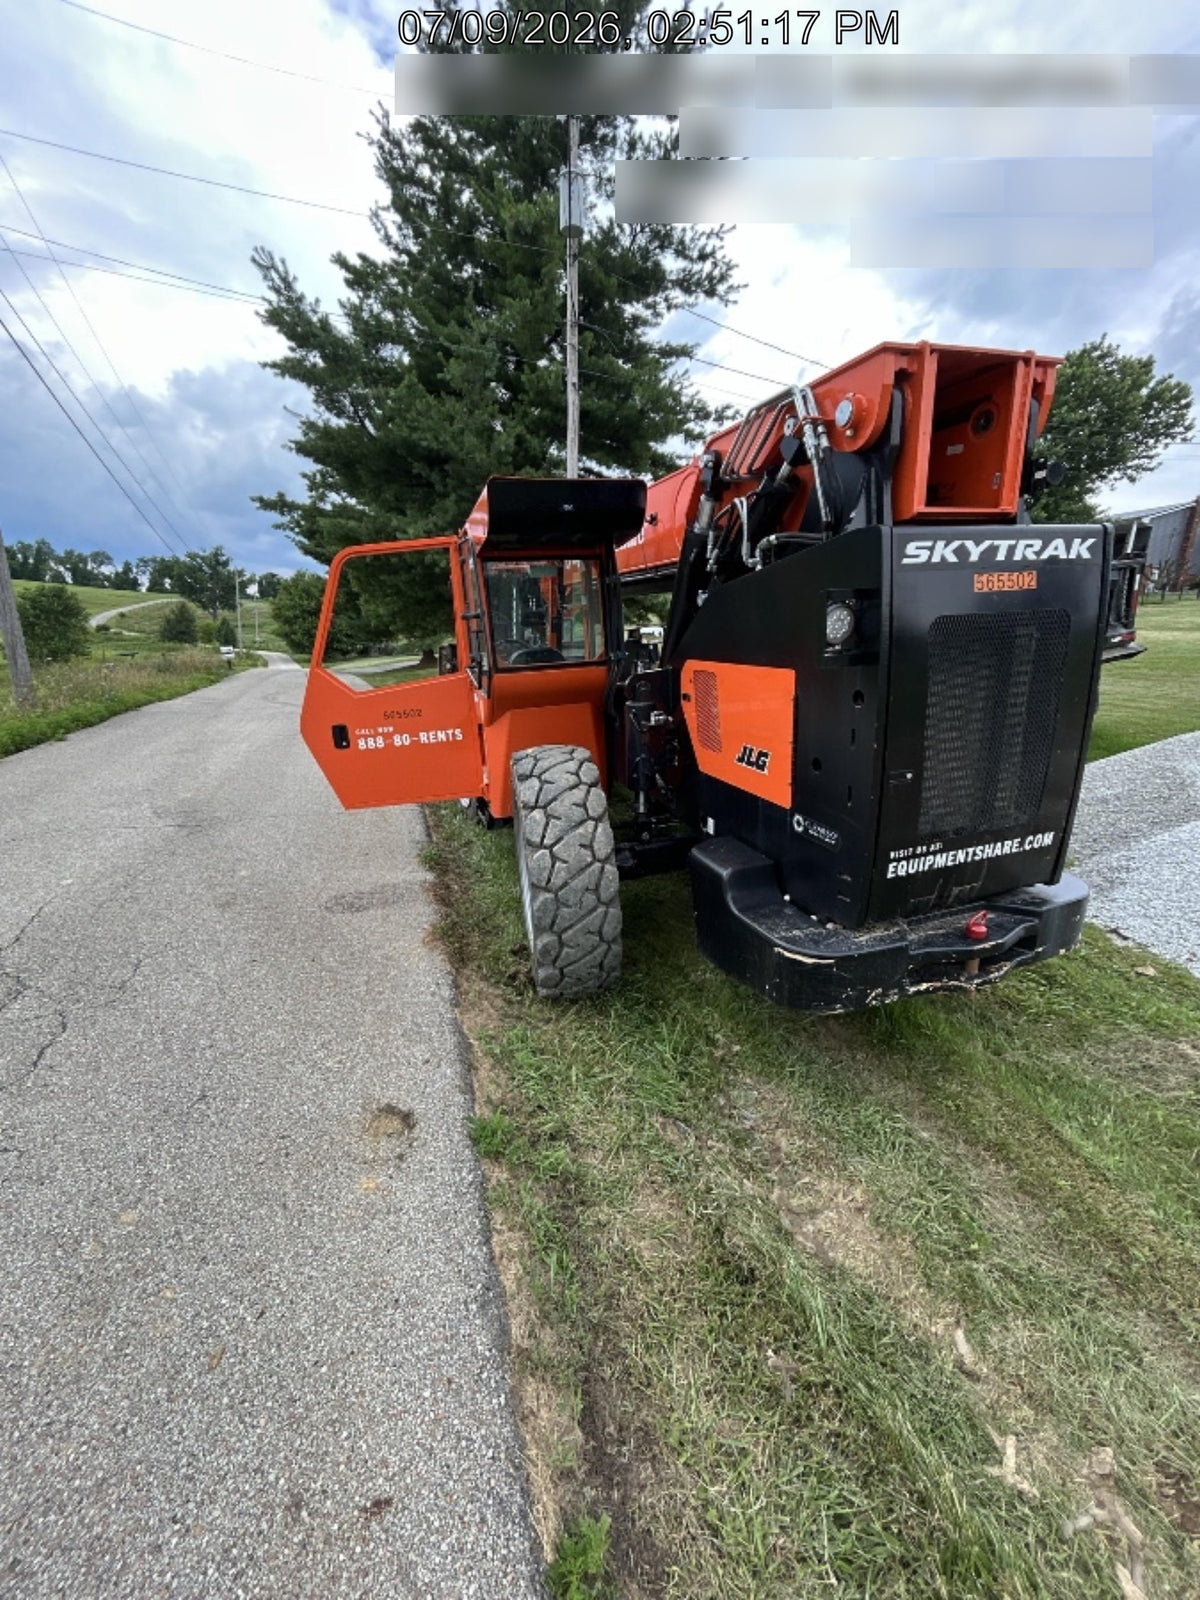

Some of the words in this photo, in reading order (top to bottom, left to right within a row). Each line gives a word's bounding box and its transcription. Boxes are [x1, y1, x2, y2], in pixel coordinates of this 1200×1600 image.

[901, 538, 1097, 564] SKYTRAK
[975, 572, 1036, 591] 565502
[358, 728, 463, 751] 888-80-RENTS
[735, 744, 771, 775] JLG
[886, 831, 1055, 879] EQUIPMENTSHARE.COM
